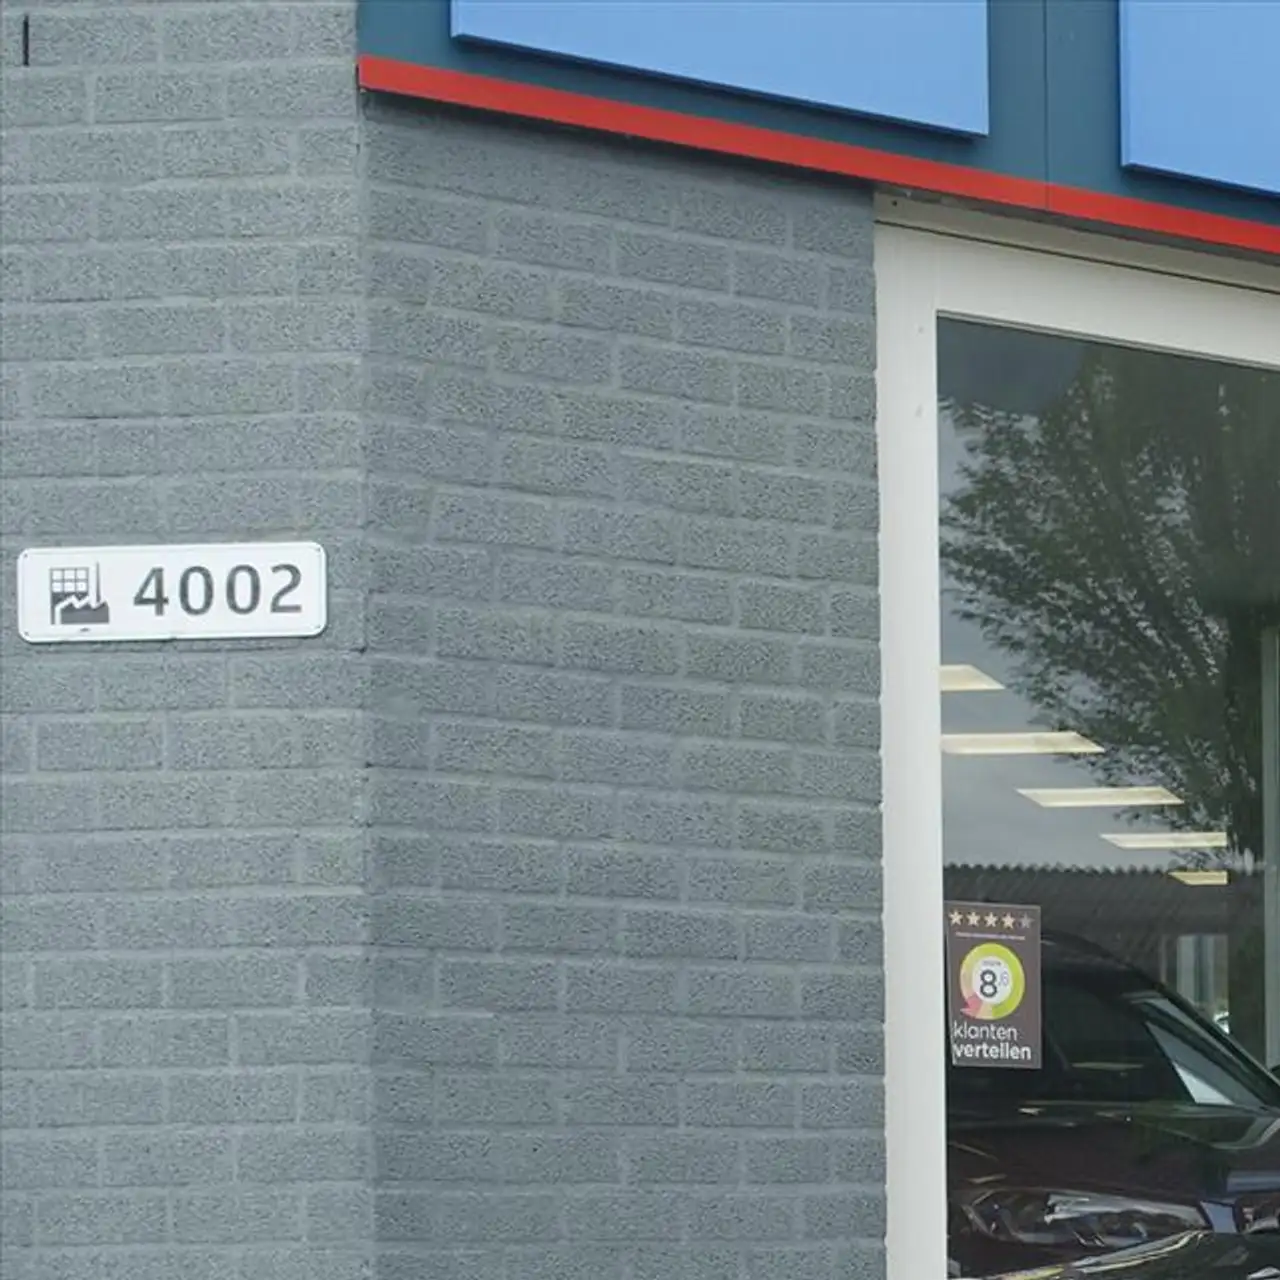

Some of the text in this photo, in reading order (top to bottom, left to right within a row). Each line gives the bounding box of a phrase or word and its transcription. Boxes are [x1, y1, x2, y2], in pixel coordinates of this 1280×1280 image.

[133, 563, 302, 616] 4002
[953, 1019, 1018, 1041] klanten
[952, 1042, 1032, 1060] vertellen
